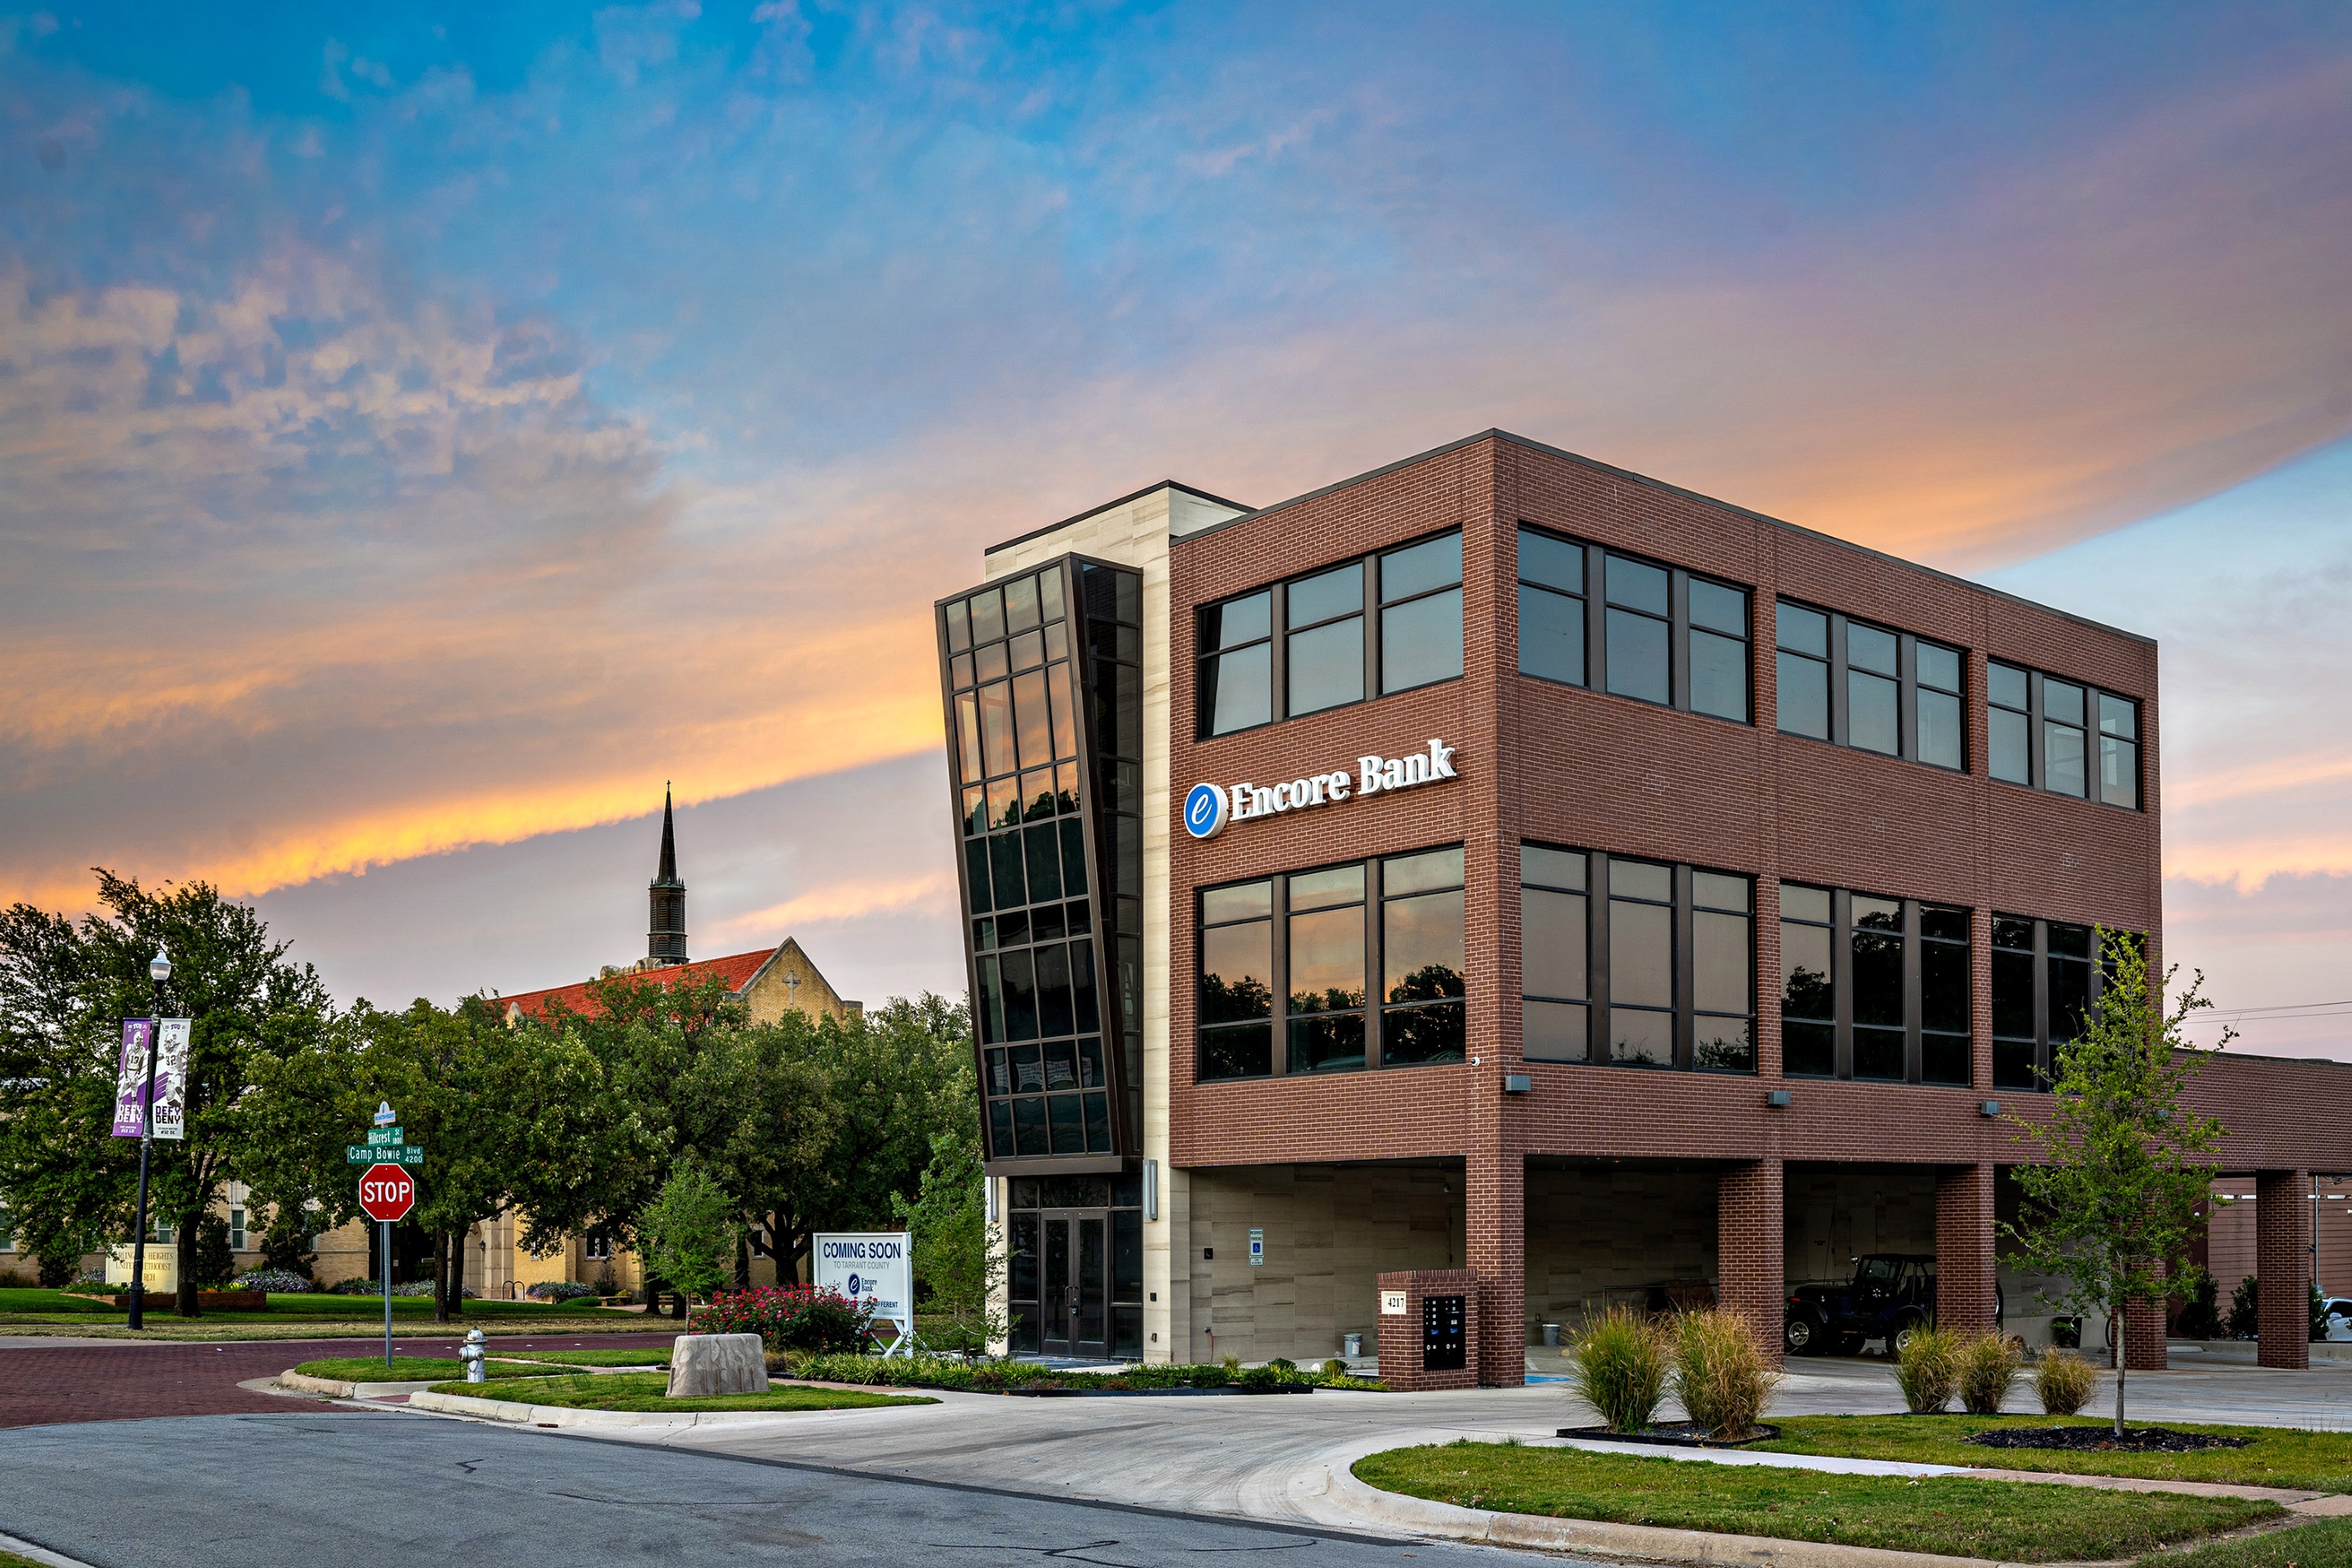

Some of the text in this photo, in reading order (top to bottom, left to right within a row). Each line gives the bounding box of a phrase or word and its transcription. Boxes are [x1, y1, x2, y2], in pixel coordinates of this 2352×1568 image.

[1229, 770, 1351, 821] Encore
[1357, 738, 1458, 795] Bank
[130, 1055, 139, 1065] 13
[166, 1054, 177, 1066] 32
[156, 1115, 180, 1124] DENY
[369, 1131, 390, 1144] Hillcrest
[350, 1147, 372, 1162] Camp
[377, 1147, 400, 1159] Bowie
[364, 1181, 410, 1203] STOP
[823, 1242, 901, 1259] COMING SOON
[1388, 1298, 1404, 1307] 4217
